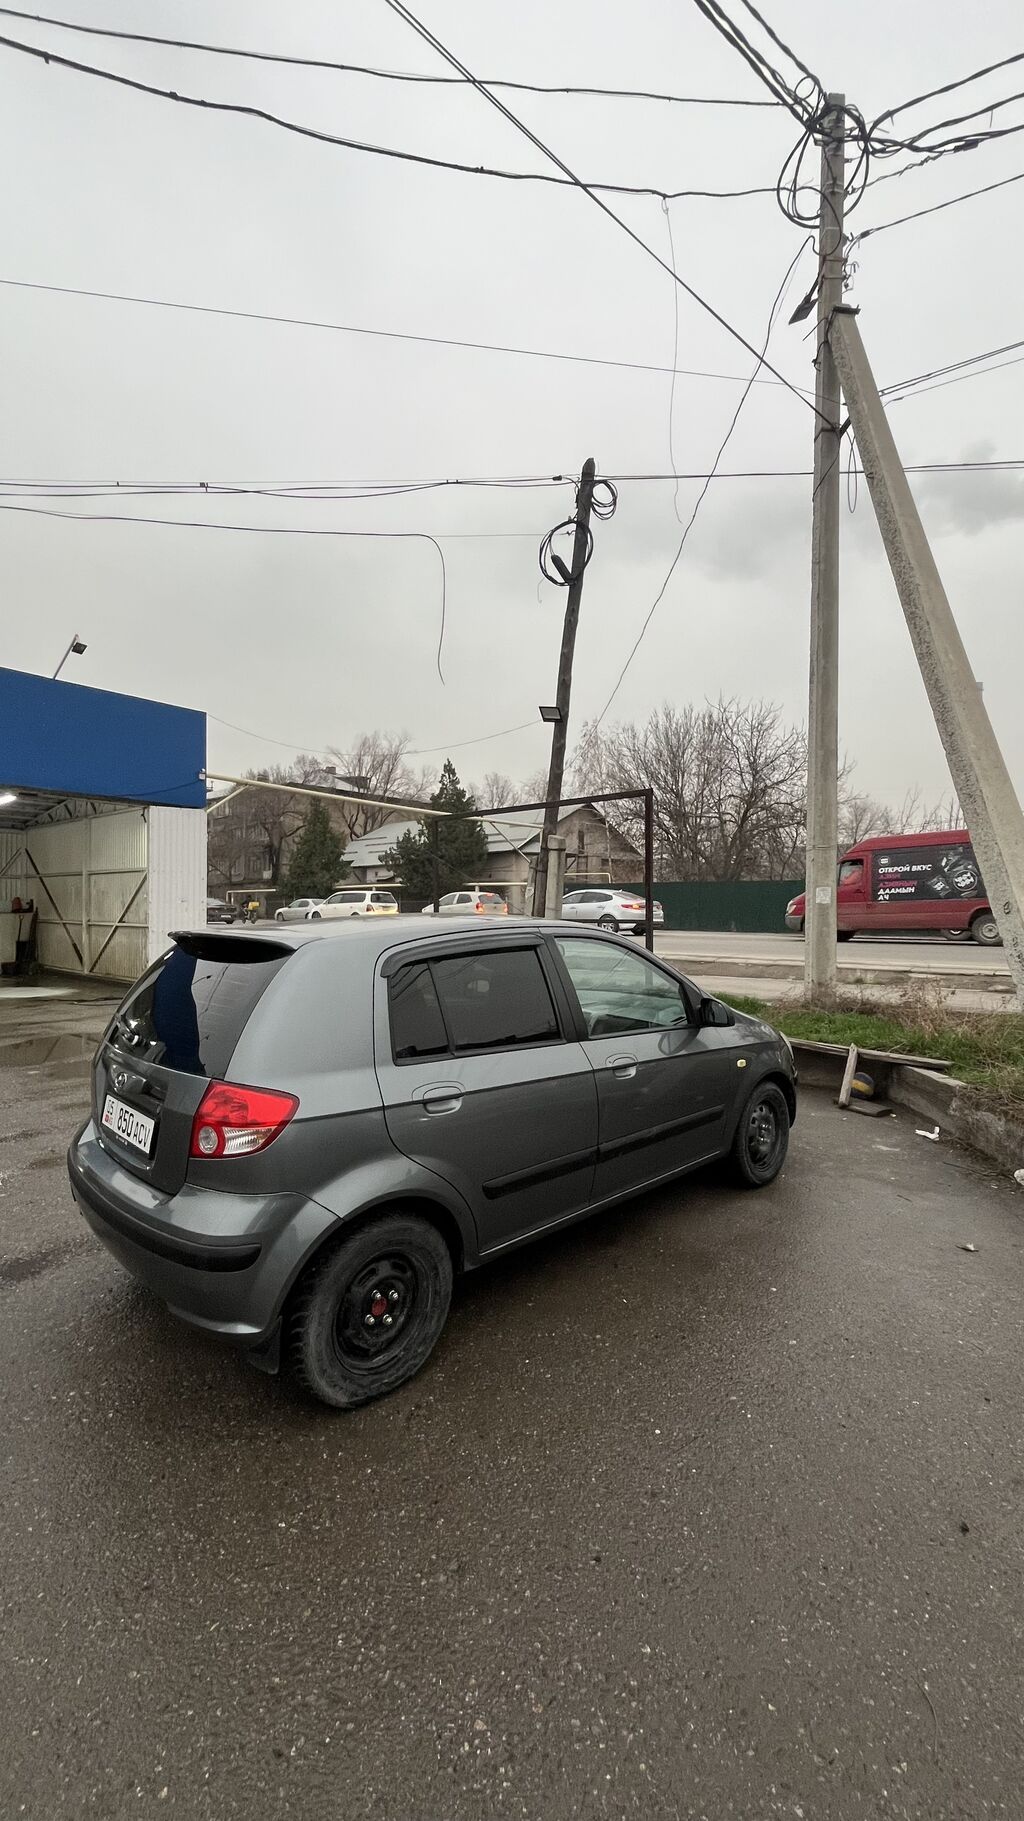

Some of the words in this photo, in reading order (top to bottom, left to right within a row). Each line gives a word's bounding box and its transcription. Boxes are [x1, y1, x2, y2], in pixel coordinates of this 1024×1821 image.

[878, 864, 910, 874] ОТКРОЙ
[911, 863, 932, 872] ВКУС
[877, 887, 915, 895] ДААМЫН
[118, 1107, 134, 1137] 850
[133, 1121, 150, 1147] ACV
